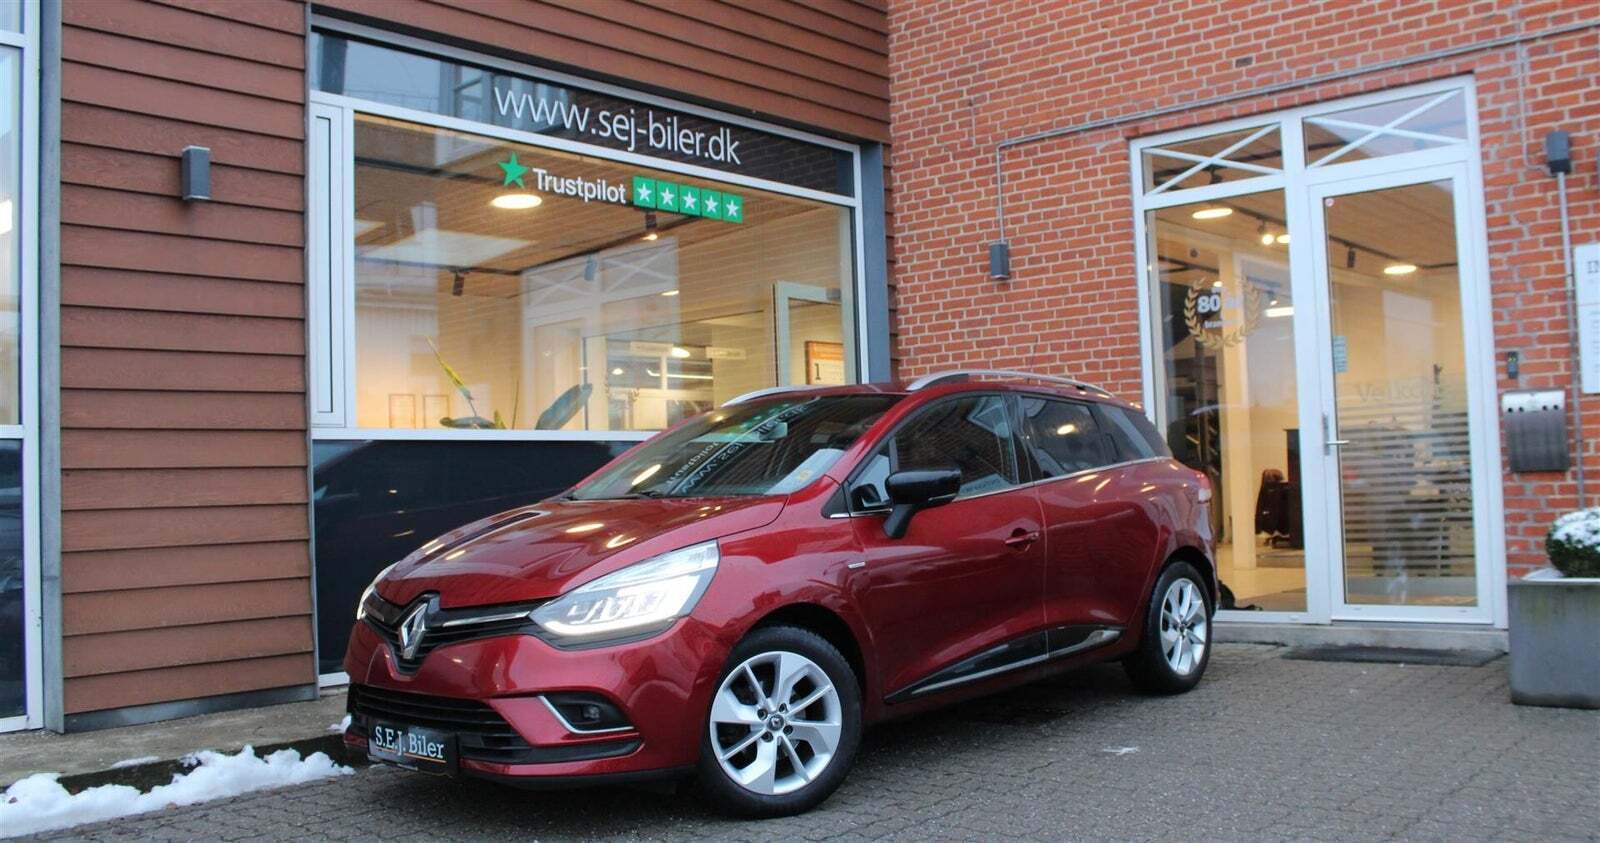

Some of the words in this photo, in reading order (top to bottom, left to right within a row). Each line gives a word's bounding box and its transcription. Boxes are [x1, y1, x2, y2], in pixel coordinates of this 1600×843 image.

[494, 86, 741, 165] www.sej-biler.dk
[531, 167, 627, 204] Trustpilot
[1197, 294, 1221, 314] 80
[375, 725, 407, 756] S.E.J.
[408, 733, 445, 759] Biler
